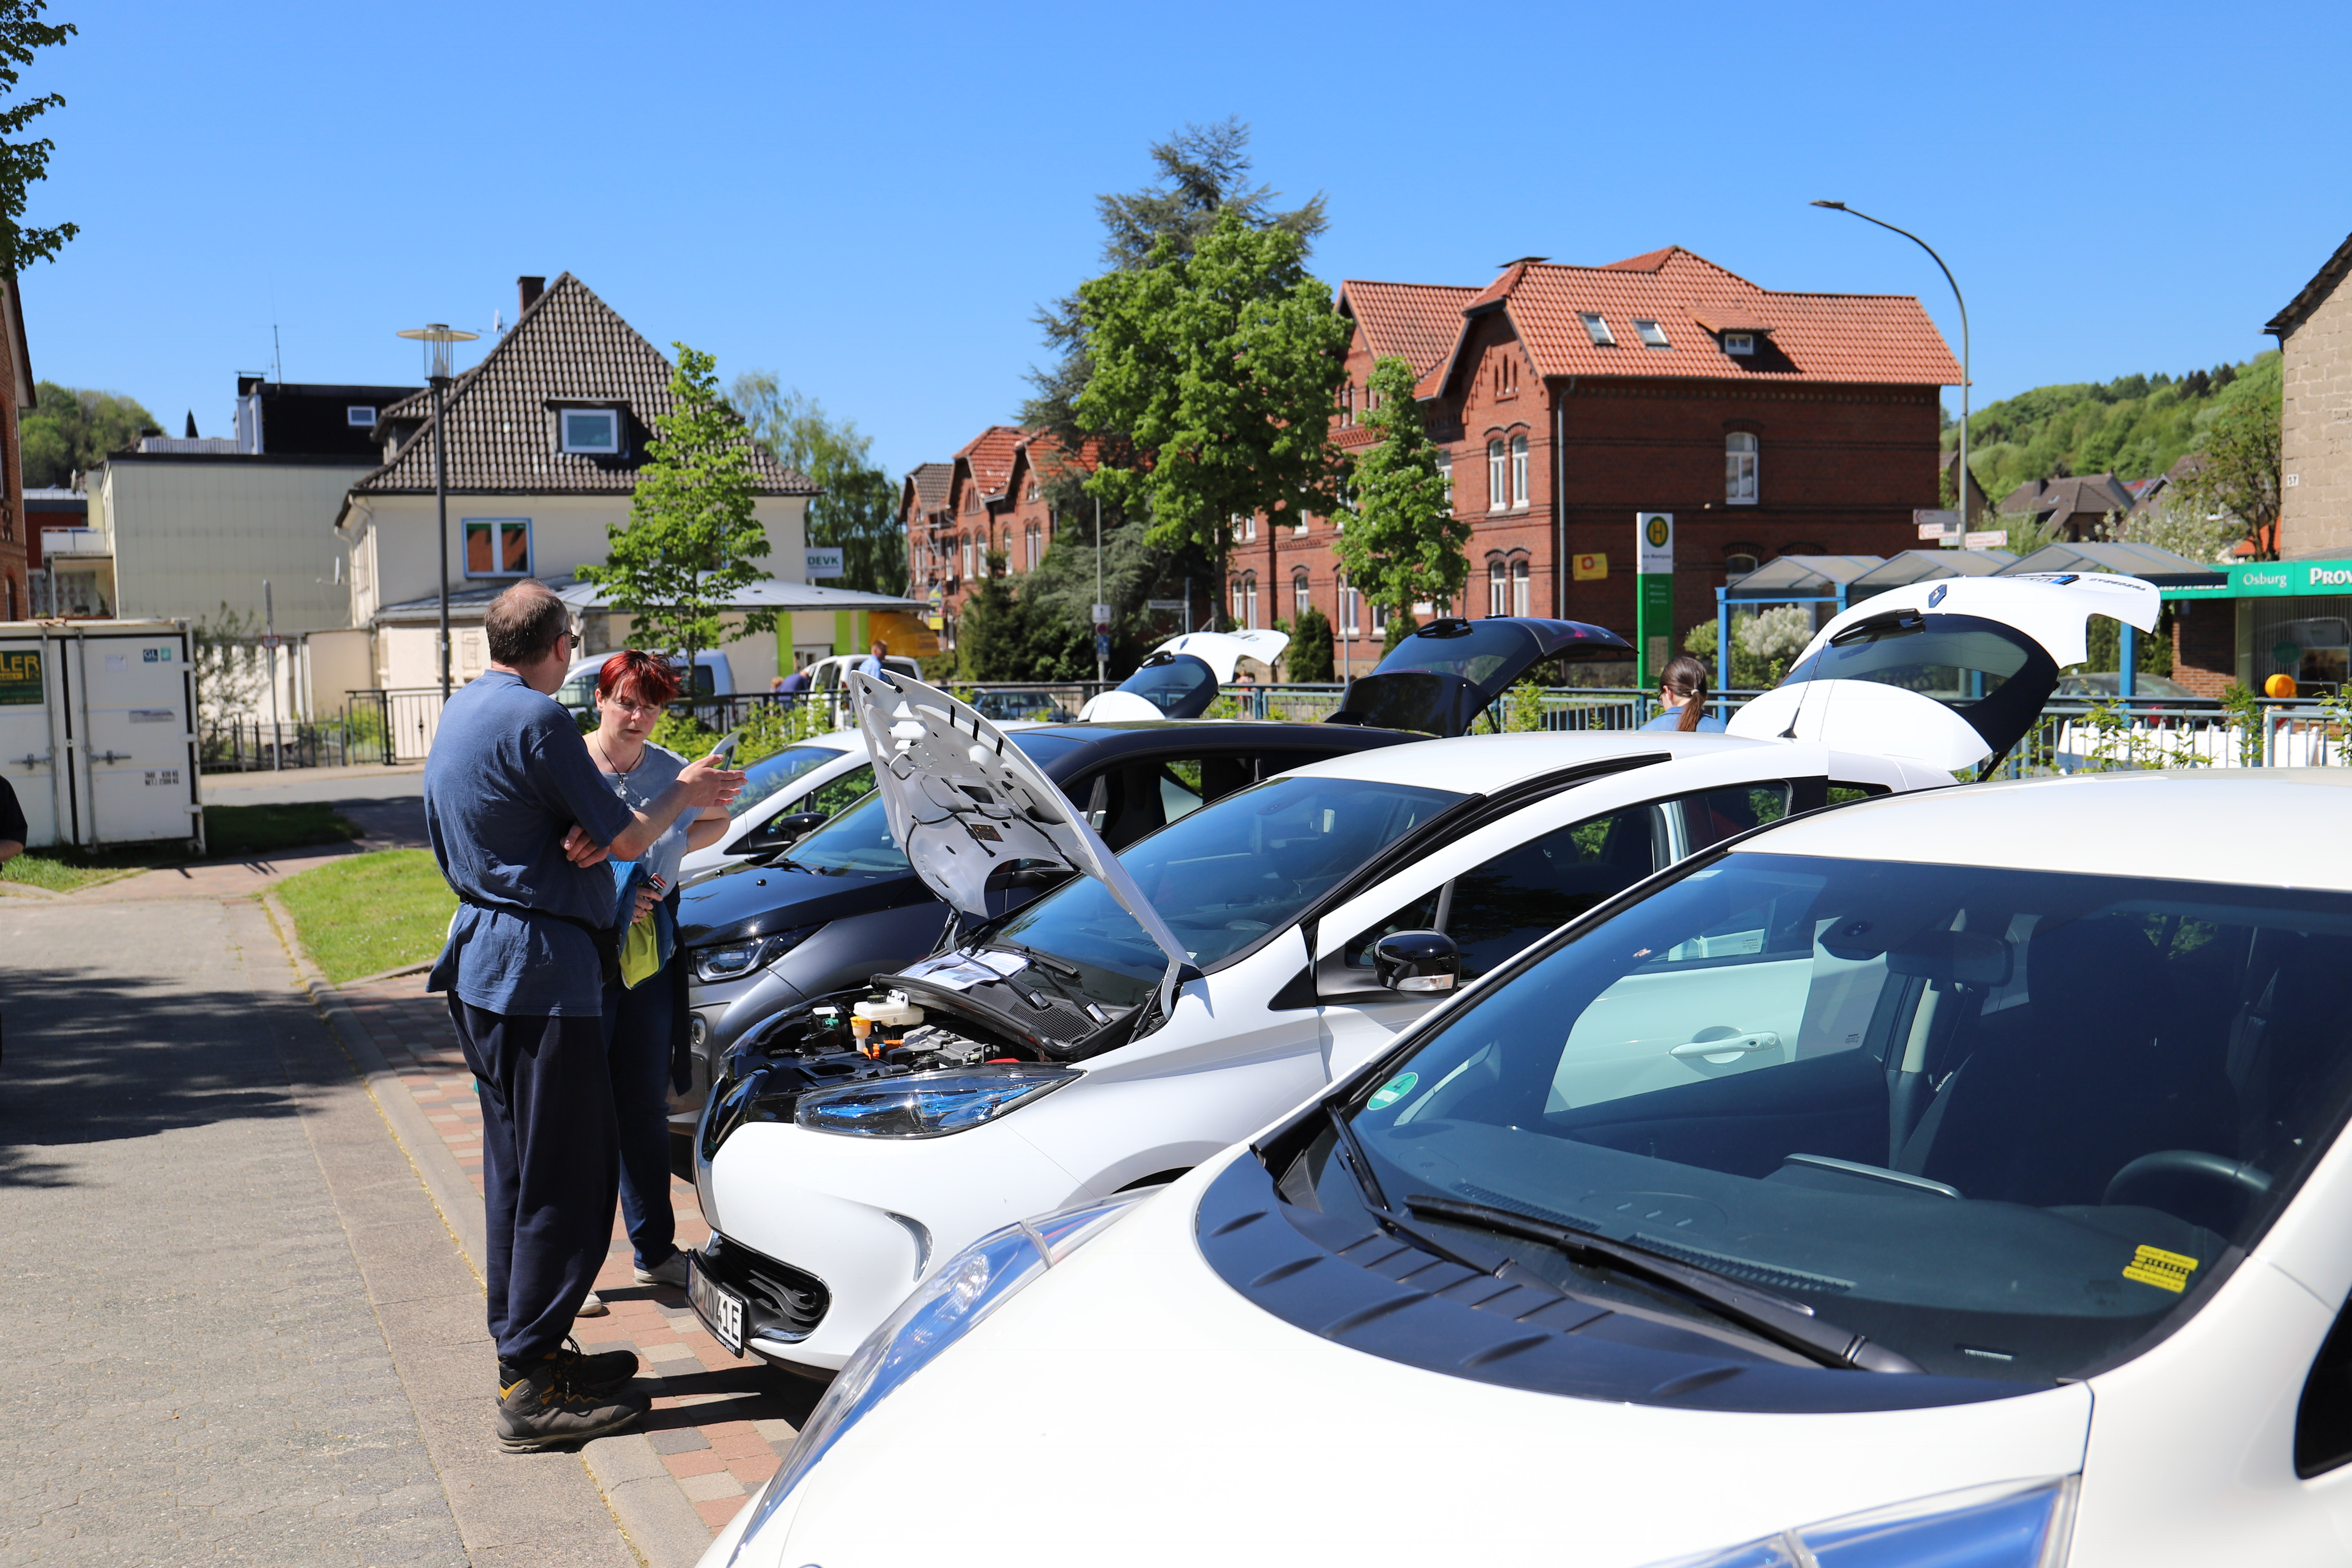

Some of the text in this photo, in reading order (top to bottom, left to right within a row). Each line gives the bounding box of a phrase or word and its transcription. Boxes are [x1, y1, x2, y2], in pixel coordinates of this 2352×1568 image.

[1653, 524, 1662, 541] H
[807, 556, 839, 565] DEVK
[2242, 572, 2287, 589] Osburg
